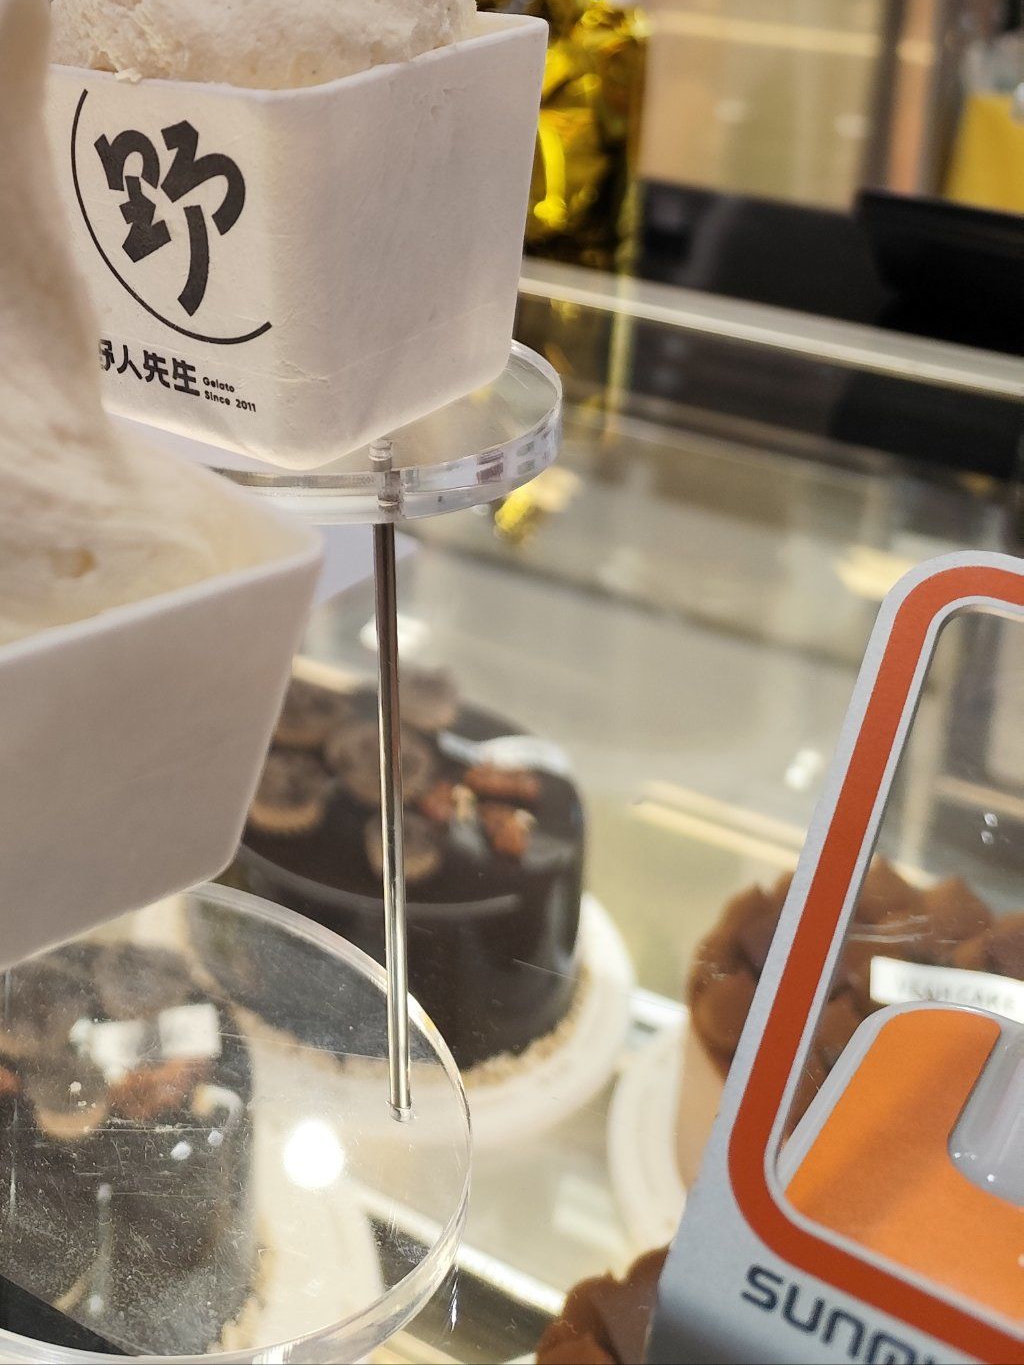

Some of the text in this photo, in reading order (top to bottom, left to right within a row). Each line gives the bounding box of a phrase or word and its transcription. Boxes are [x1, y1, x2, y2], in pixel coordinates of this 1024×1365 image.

[94, 120, 246, 317] 野
[202, 376, 236, 393] Gelato
[204, 389, 257, 413] Since 2011
